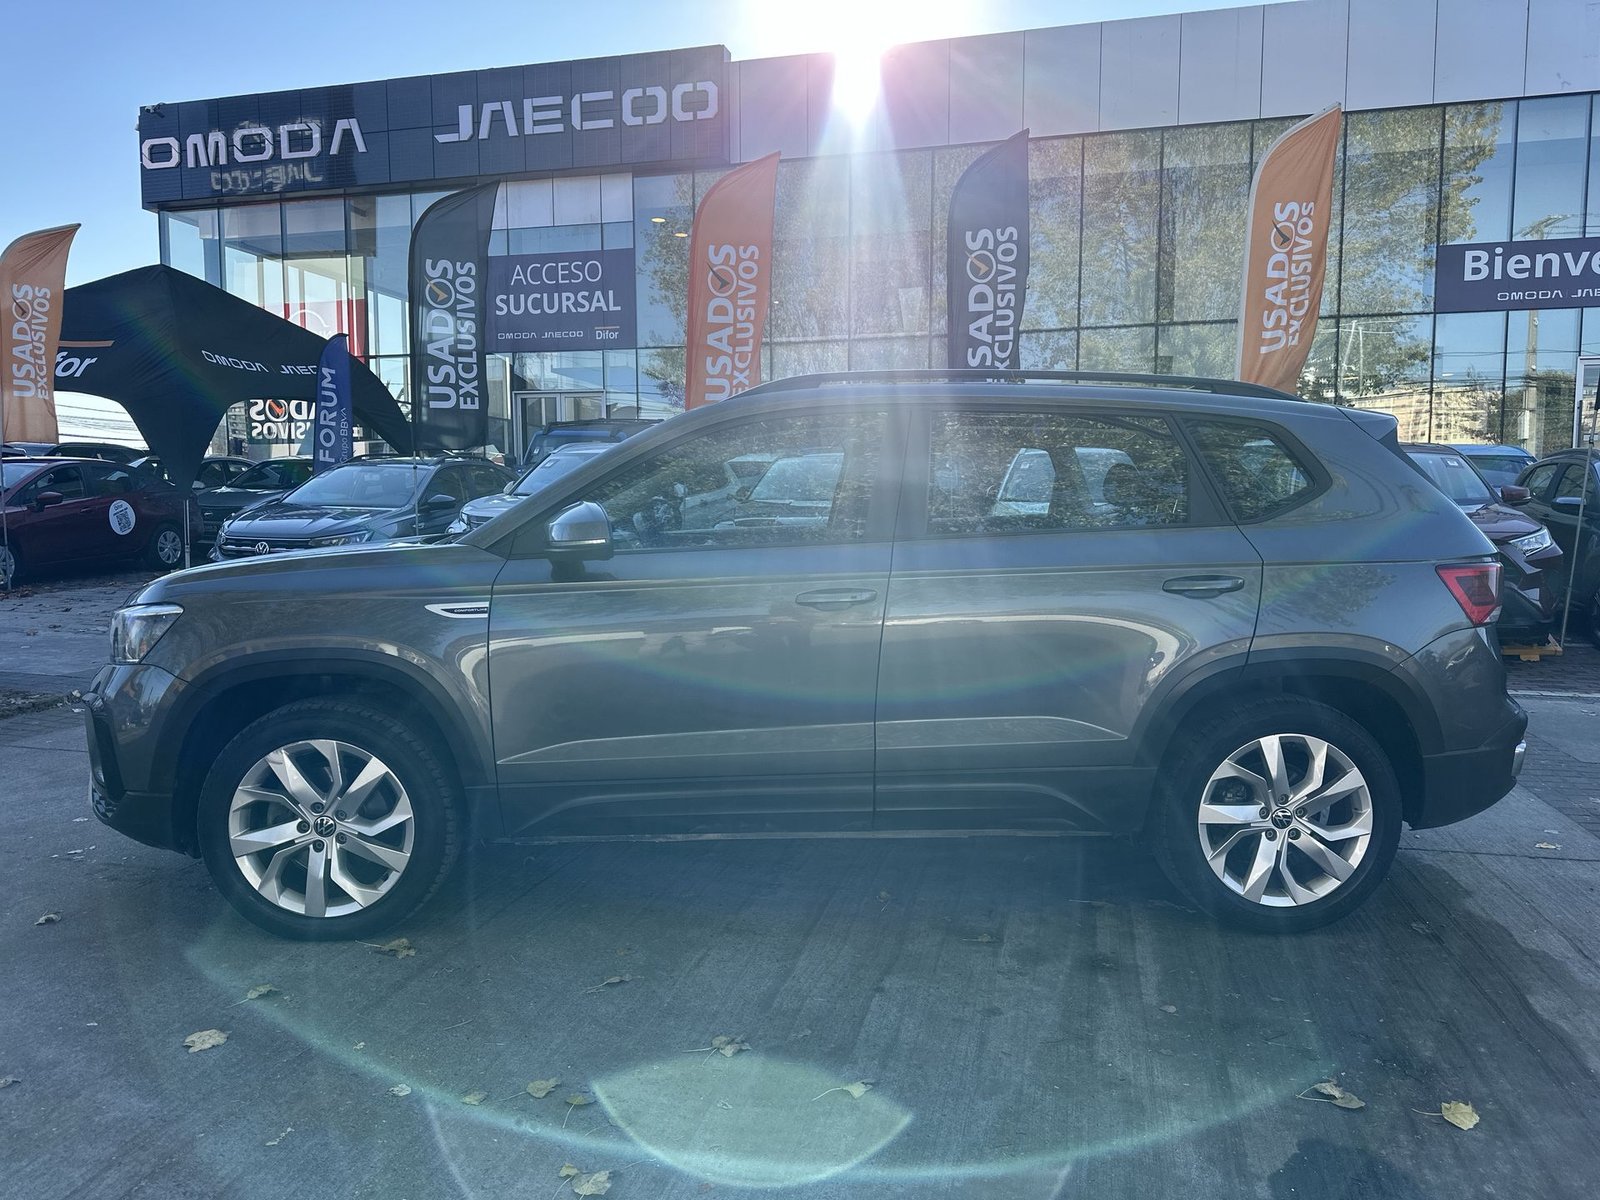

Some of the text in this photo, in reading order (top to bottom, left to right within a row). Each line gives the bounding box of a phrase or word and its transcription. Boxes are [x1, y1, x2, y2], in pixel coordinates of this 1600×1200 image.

[142, 80, 719, 169] OMODA JAECOO
[495, 290, 622, 316] SUCURSAL
[510, 260, 602, 286] ACCESO
[705, 244, 737, 401] USADOS
[965, 228, 996, 367] SADOS
[994, 226, 1018, 369] XCLUSIVOS
[1260, 201, 1300, 354] USADOS
[1288, 202, 1314, 347] EXCLUSIVOS
[1497, 290, 1563, 301] OMODA
[12, 283, 36, 397] USADOS
[32, 287, 51, 400] EXCLUSIVOS
[201, 350, 269, 373] OMODA
[425, 258, 457, 409] USADOS
[455, 261, 479, 410] EXCLUSIVOS
[498, 329, 619, 340] OMODA JAECOO Difor
[319, 367, 338, 463] FORUM
[340, 407, 348, 436] BBVA
